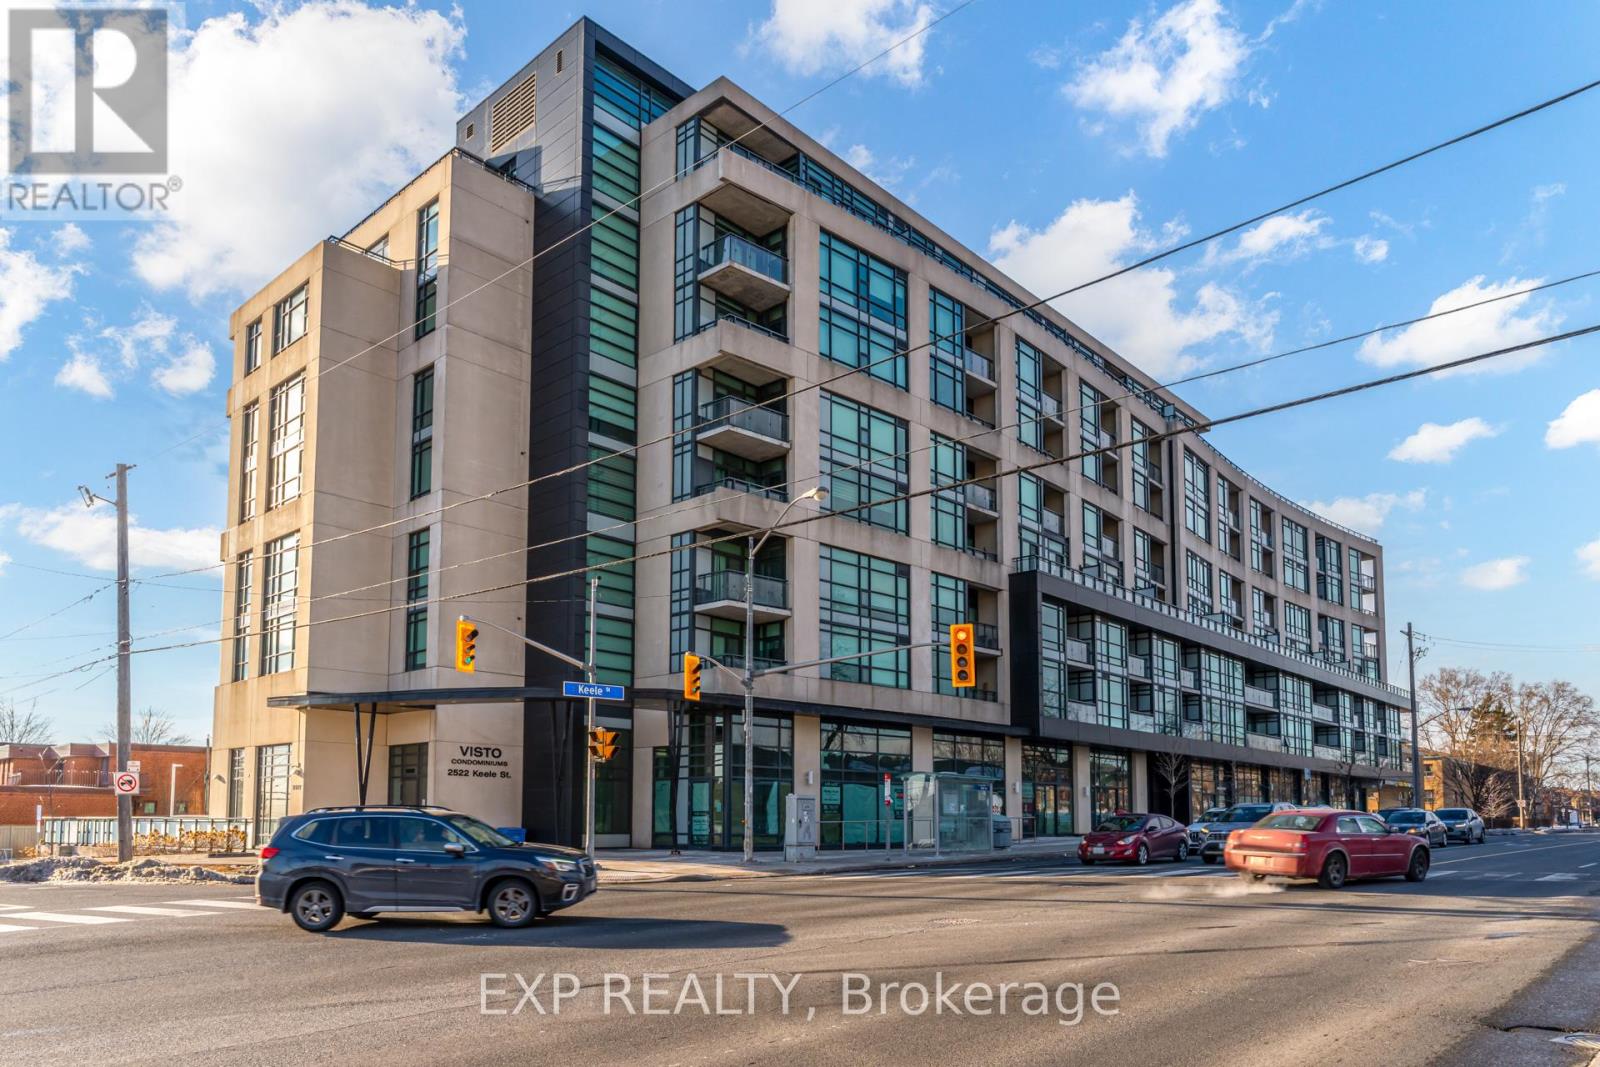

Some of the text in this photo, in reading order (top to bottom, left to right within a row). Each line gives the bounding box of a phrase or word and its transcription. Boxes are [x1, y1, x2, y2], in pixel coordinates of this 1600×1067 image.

[578, 684, 604, 696] Keele
[459, 745, 502, 759] VISTO
[450, 758, 509, 767] CONDOMINIUMS
[447, 768, 512, 779] 2522 Keele St.
